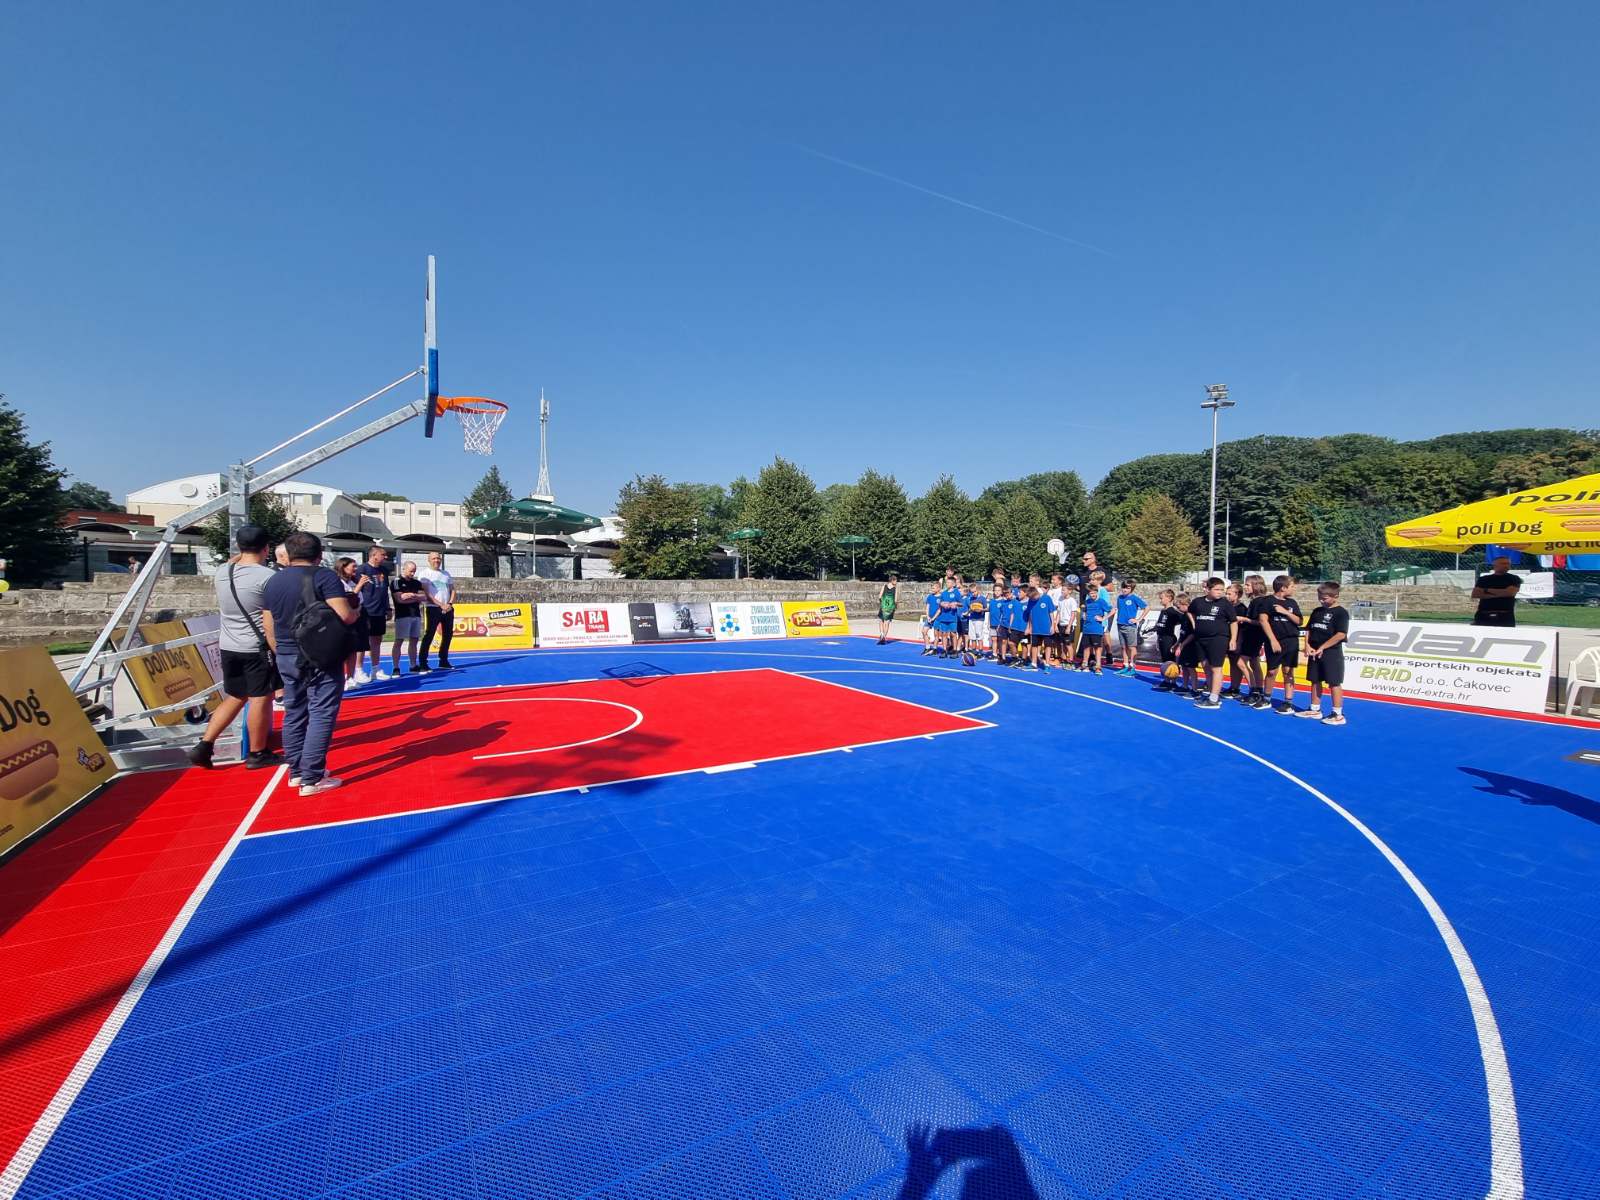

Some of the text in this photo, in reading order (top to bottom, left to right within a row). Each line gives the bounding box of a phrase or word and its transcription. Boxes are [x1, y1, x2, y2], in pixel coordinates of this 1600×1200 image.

[1457, 521, 1543, 539] poli Dog
[453, 618, 478, 631] oli
[1346, 626, 1547, 663] elan
[1407, 659, 1471, 672] sportskih
[1476, 665, 1542, 678] objekata
[1360, 666, 1511, 693] BRID d.o.o. Čakovec
[1371, 683, 1472, 701] www.brid-extra.hr
